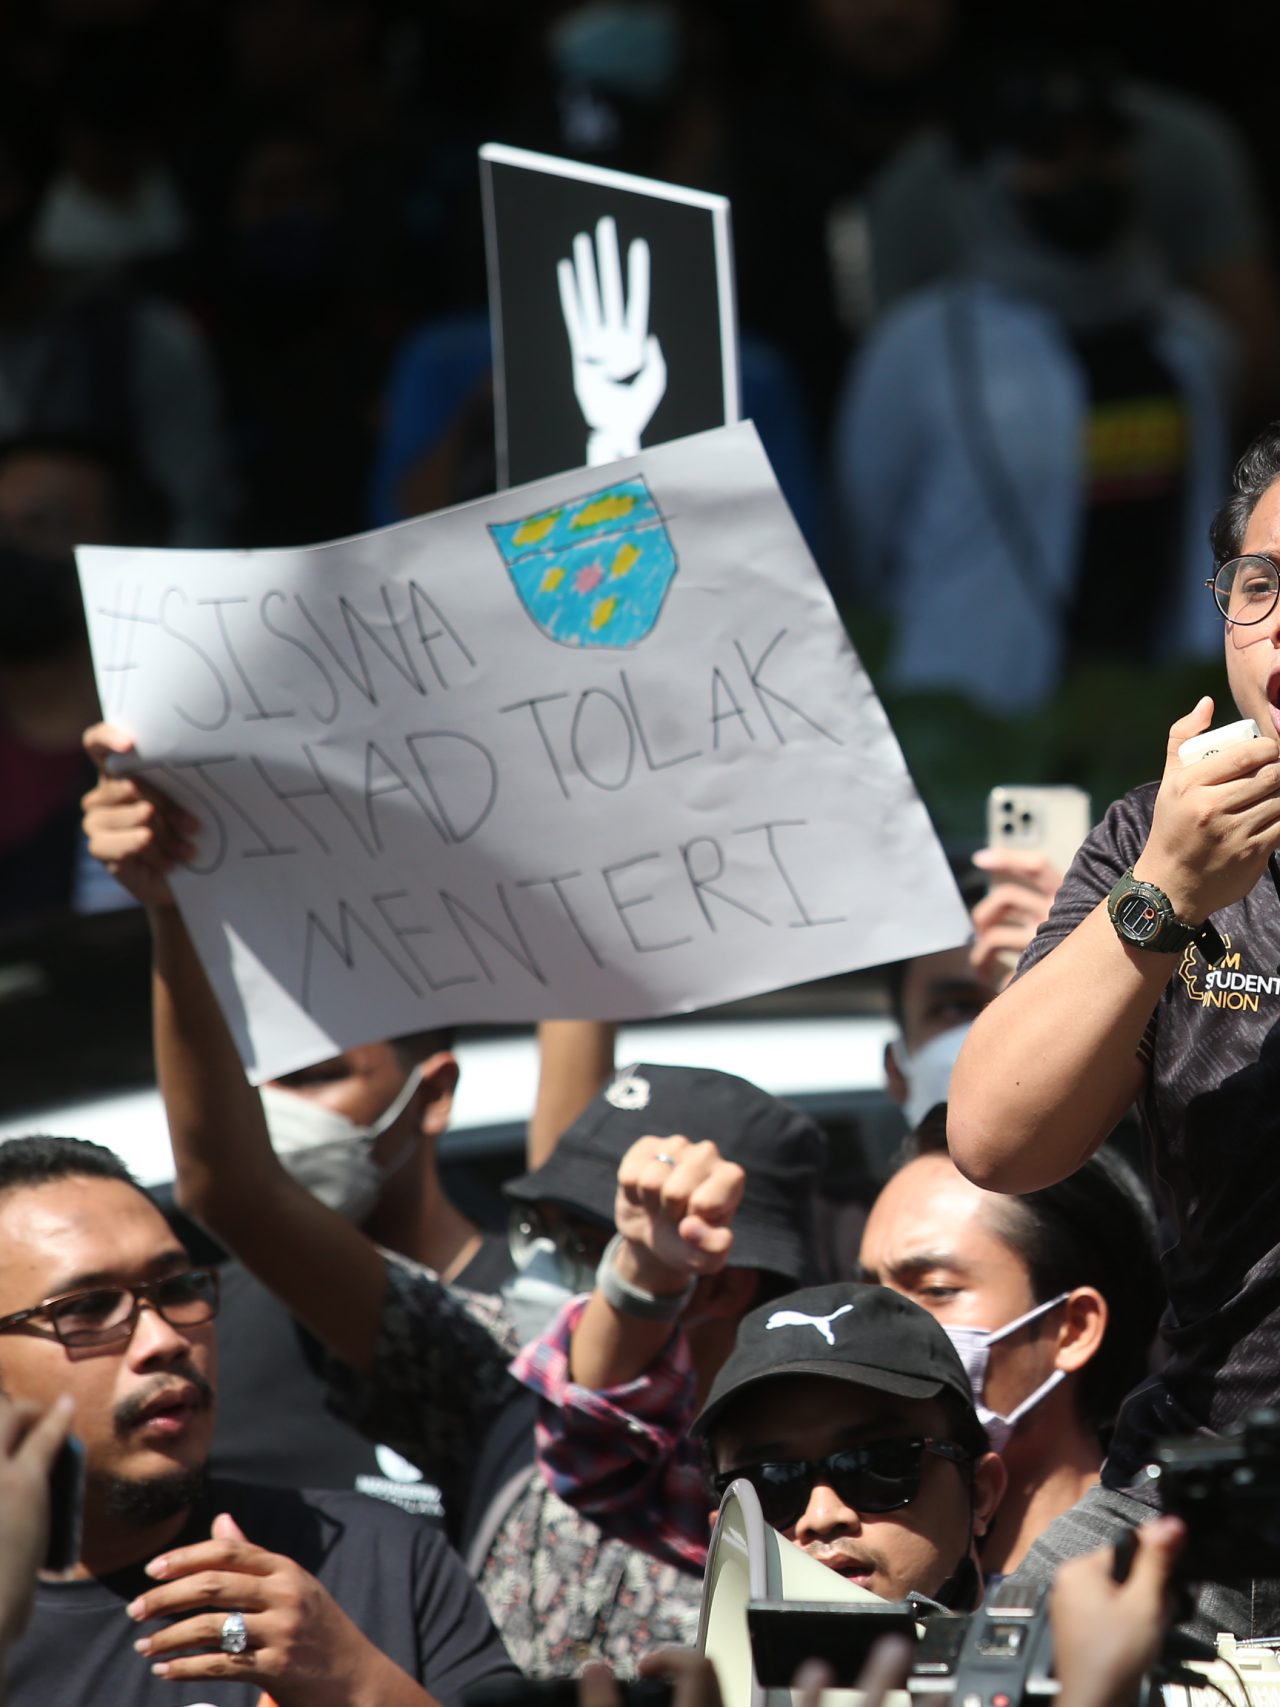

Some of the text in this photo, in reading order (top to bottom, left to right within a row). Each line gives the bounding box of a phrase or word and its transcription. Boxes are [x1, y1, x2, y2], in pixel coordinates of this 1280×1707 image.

[97, 579, 476, 731] #SISWA
[499, 628, 846, 799] TOLAK
[300, 819, 848, 1012] MENTERI
